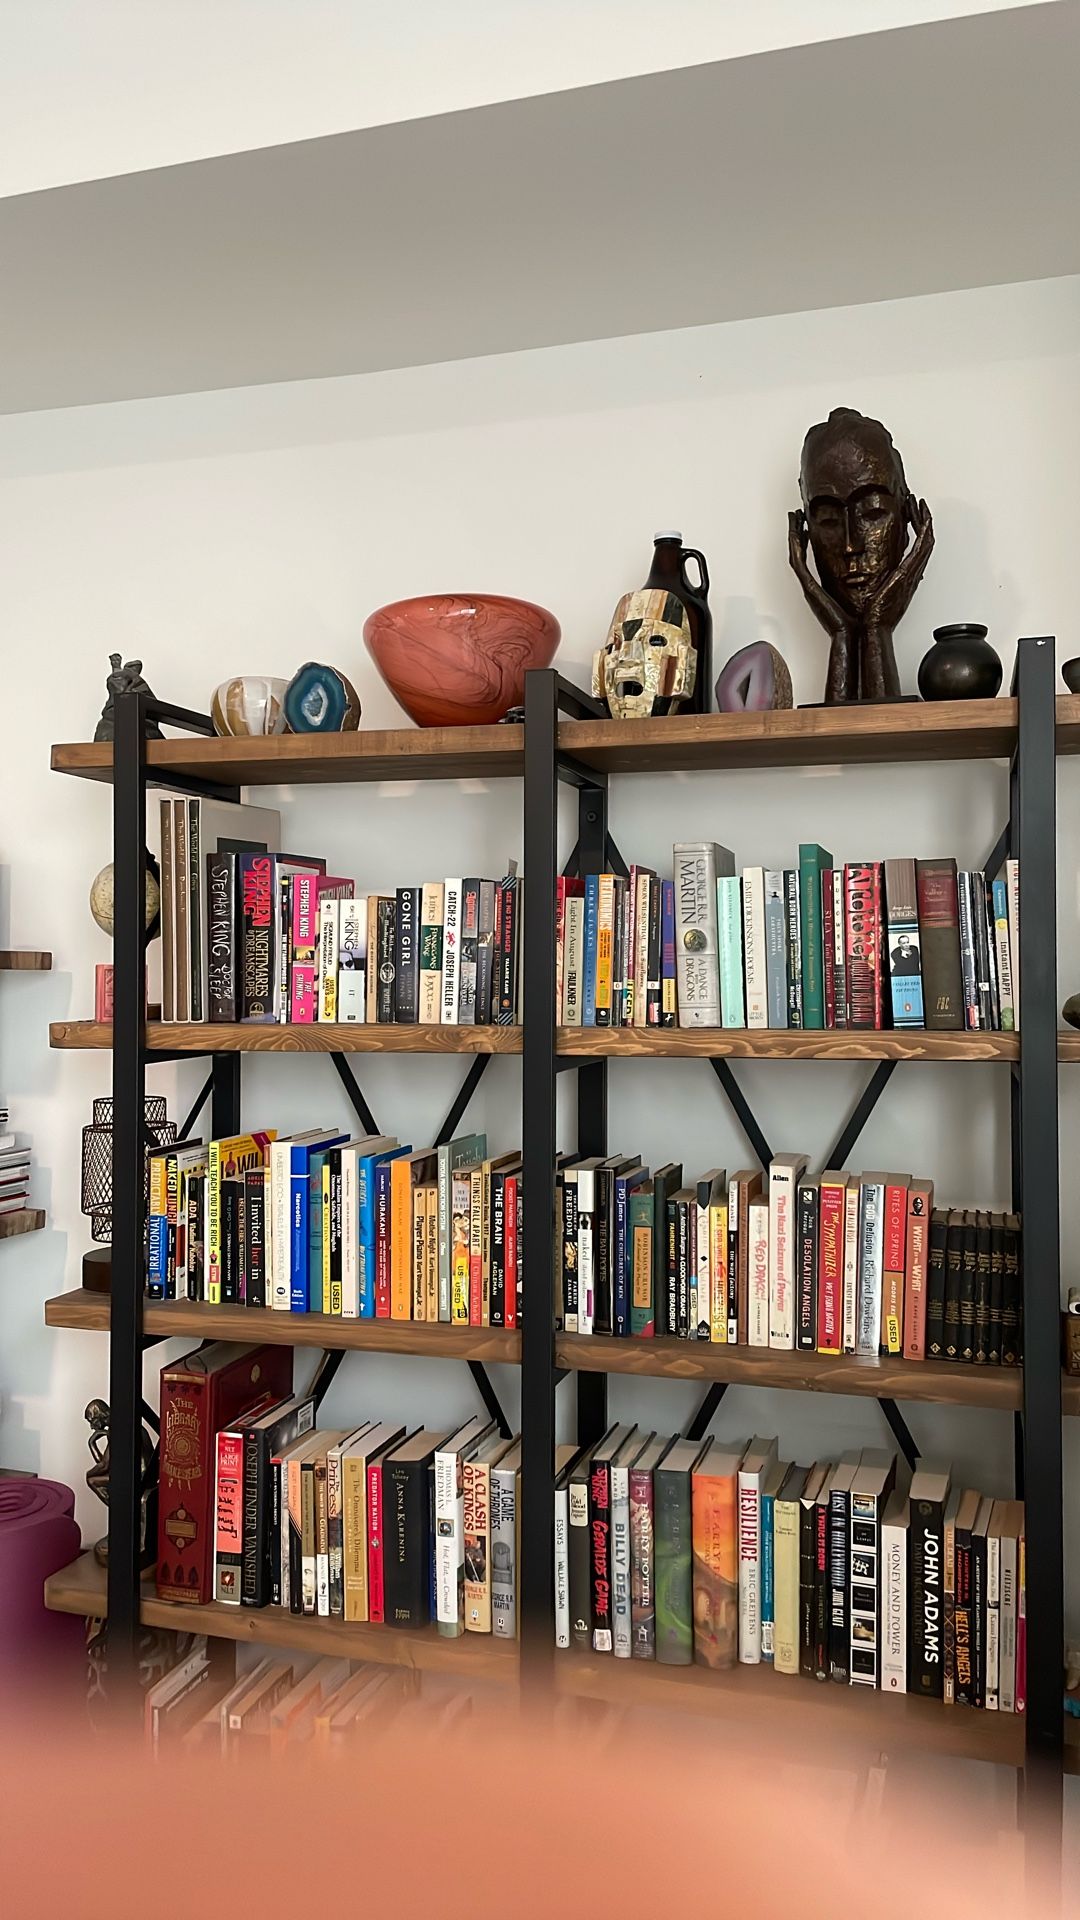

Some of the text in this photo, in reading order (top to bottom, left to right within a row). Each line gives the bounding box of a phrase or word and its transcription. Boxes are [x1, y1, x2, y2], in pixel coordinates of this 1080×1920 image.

[244, 870, 257, 915] KING
[252, 858, 270, 926] STEPHEN
[680, 860, 696, 924] MARTIN
[788, 873, 796, 898] NATURAL
[210, 865, 230, 957] STEPHEN KING
[300, 880, 309, 938] STEPHEN KING
[402, 891, 411, 966] GONE GIRL
[745, 905, 753, 955] DICKINSON'S
[789, 918, 797, 940] HEROES
[344, 921, 354, 950] KING
[445, 891, 456, 1006] CATCH-22 JOSEPH HELLER
[567, 900, 577, 1005] Light In August FAULKNER
[208, 963, 222, 1000] SLEEP
[221, 963, 233, 1000] DOCTOR
[255, 930, 268, 997] NIGHTMARES
[685, 958, 695, 1001] DRAGONS
[698, 968, 708, 1000] DANCE
[746, 957, 754, 984] POEMS
[1000, 942, 1010, 996] Instant HAPPY
[295, 973, 304, 1000] SHINING
[151, 1162, 161, 1215] PREDICTABLY
[167, 1159, 177, 1224] NAKED LUNCH
[617, 1200, 625, 1221] James
[618, 1188, 625, 1200] PD
[891, 1190, 900, 1213] RITES
[189, 1222, 197, 1246] Vladimir
[211, 1209, 217, 1217] TO
[211, 1219, 217, 1228] BE
[251, 1204, 261, 1244] invited
[472, 1206, 480, 1221] FALL
[494, 1188, 503, 1244] THE BRAIN
[831, 1212, 839, 1223] THE
[892, 1217, 900, 1229] OF
[150, 1217, 160, 1270] IRRATIONAL
[251, 1247, 261, 1266] her
[472, 1223, 480, 1248] APART
[776, 1195, 785, 1312] The Nazi Seizure of Power
[824, 1221, 836, 1278] SYMPATHIZER
[890, 1234, 899, 1268] SPRING
[189, 1247, 197, 1272] Nabokov
[251, 1268, 261, 1280] in
[618, 1275, 623, 1284] OF
[863, 1188, 875, 1334] The GOD Delusion Richard Dawkins
[912, 1226, 922, 1292] WHAT WHAT
[454, 1282, 463, 1304] USED
[802, 1239, 812, 1327] DESOLATION ANGELS
[889, 1320, 897, 1343] USED
[176, 1397, 194, 1410] THE
[328, 1459, 339, 1515] Princess
[464, 1465, 474, 1531] OF KINGS
[475, 1469, 486, 1530] A CLASH
[490, 1478, 500, 1530] OF THRONES
[502, 1488, 514, 1522] A GAME
[592, 1475, 600, 1501] KING
[597, 1468, 608, 1509] STEPHEN
[244, 1442, 258, 1595] JOSEPH FINDER VANISHED
[396, 1483, 406, 1562] ANNA KARENINA
[556, 1519, 564, 1545] ESSAYS
[741, 1489, 758, 1562] RESILIENCE
[557, 1561, 565, 1588] WALLACE
[615, 1523, 626, 1615] BILLY DEAD
[640, 1502, 650, 1607] HARRY POTTER
[831, 1491, 846, 1627] LOST IN HOLLYWOOD JOHN GLATT
[892, 1543, 900, 1655] MONEY AND POWER
[924, 1528, 939, 1663] JOHN ADAMS
[955, 1611, 971, 1684] HELL'S ANGELS
